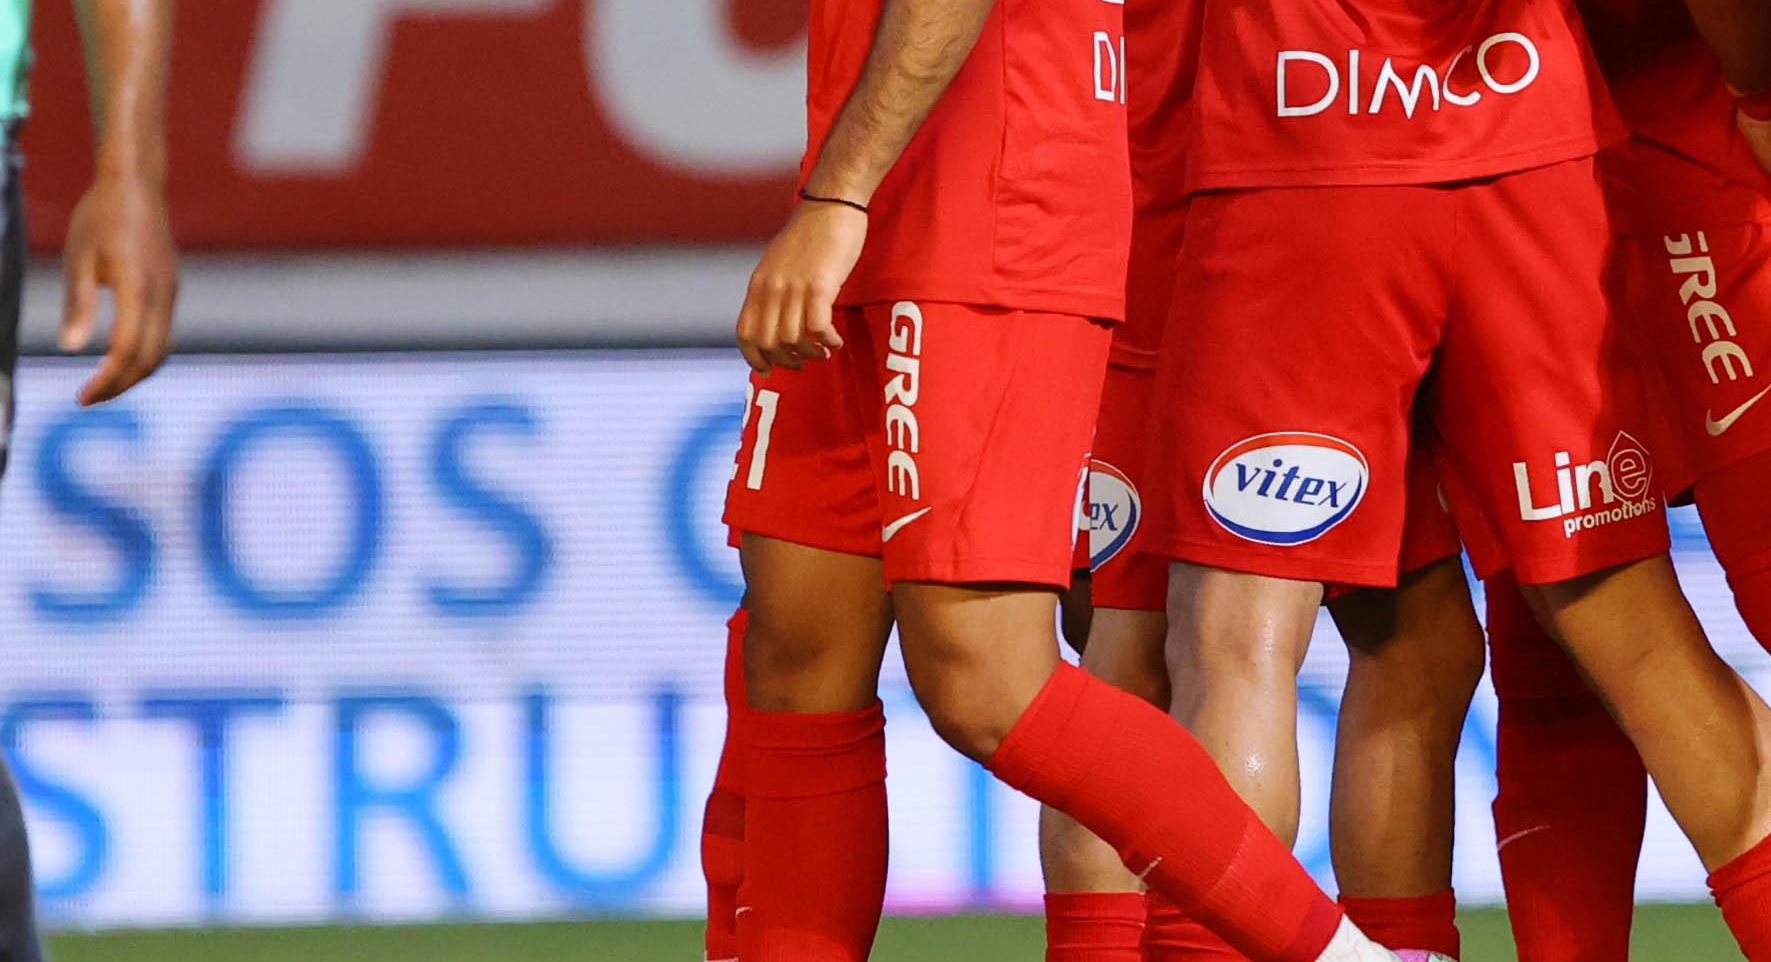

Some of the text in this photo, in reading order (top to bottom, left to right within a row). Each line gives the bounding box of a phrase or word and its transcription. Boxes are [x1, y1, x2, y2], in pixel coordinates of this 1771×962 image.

[1276, 32, 1540, 118] DIMCO
[732, 381, 780, 490] 1
[885, 300, 923, 501] GREE
[1234, 459, 1348, 510] vitex
[1512, 446, 1650, 521] Line
[1563, 494, 1657, 538] promotions
